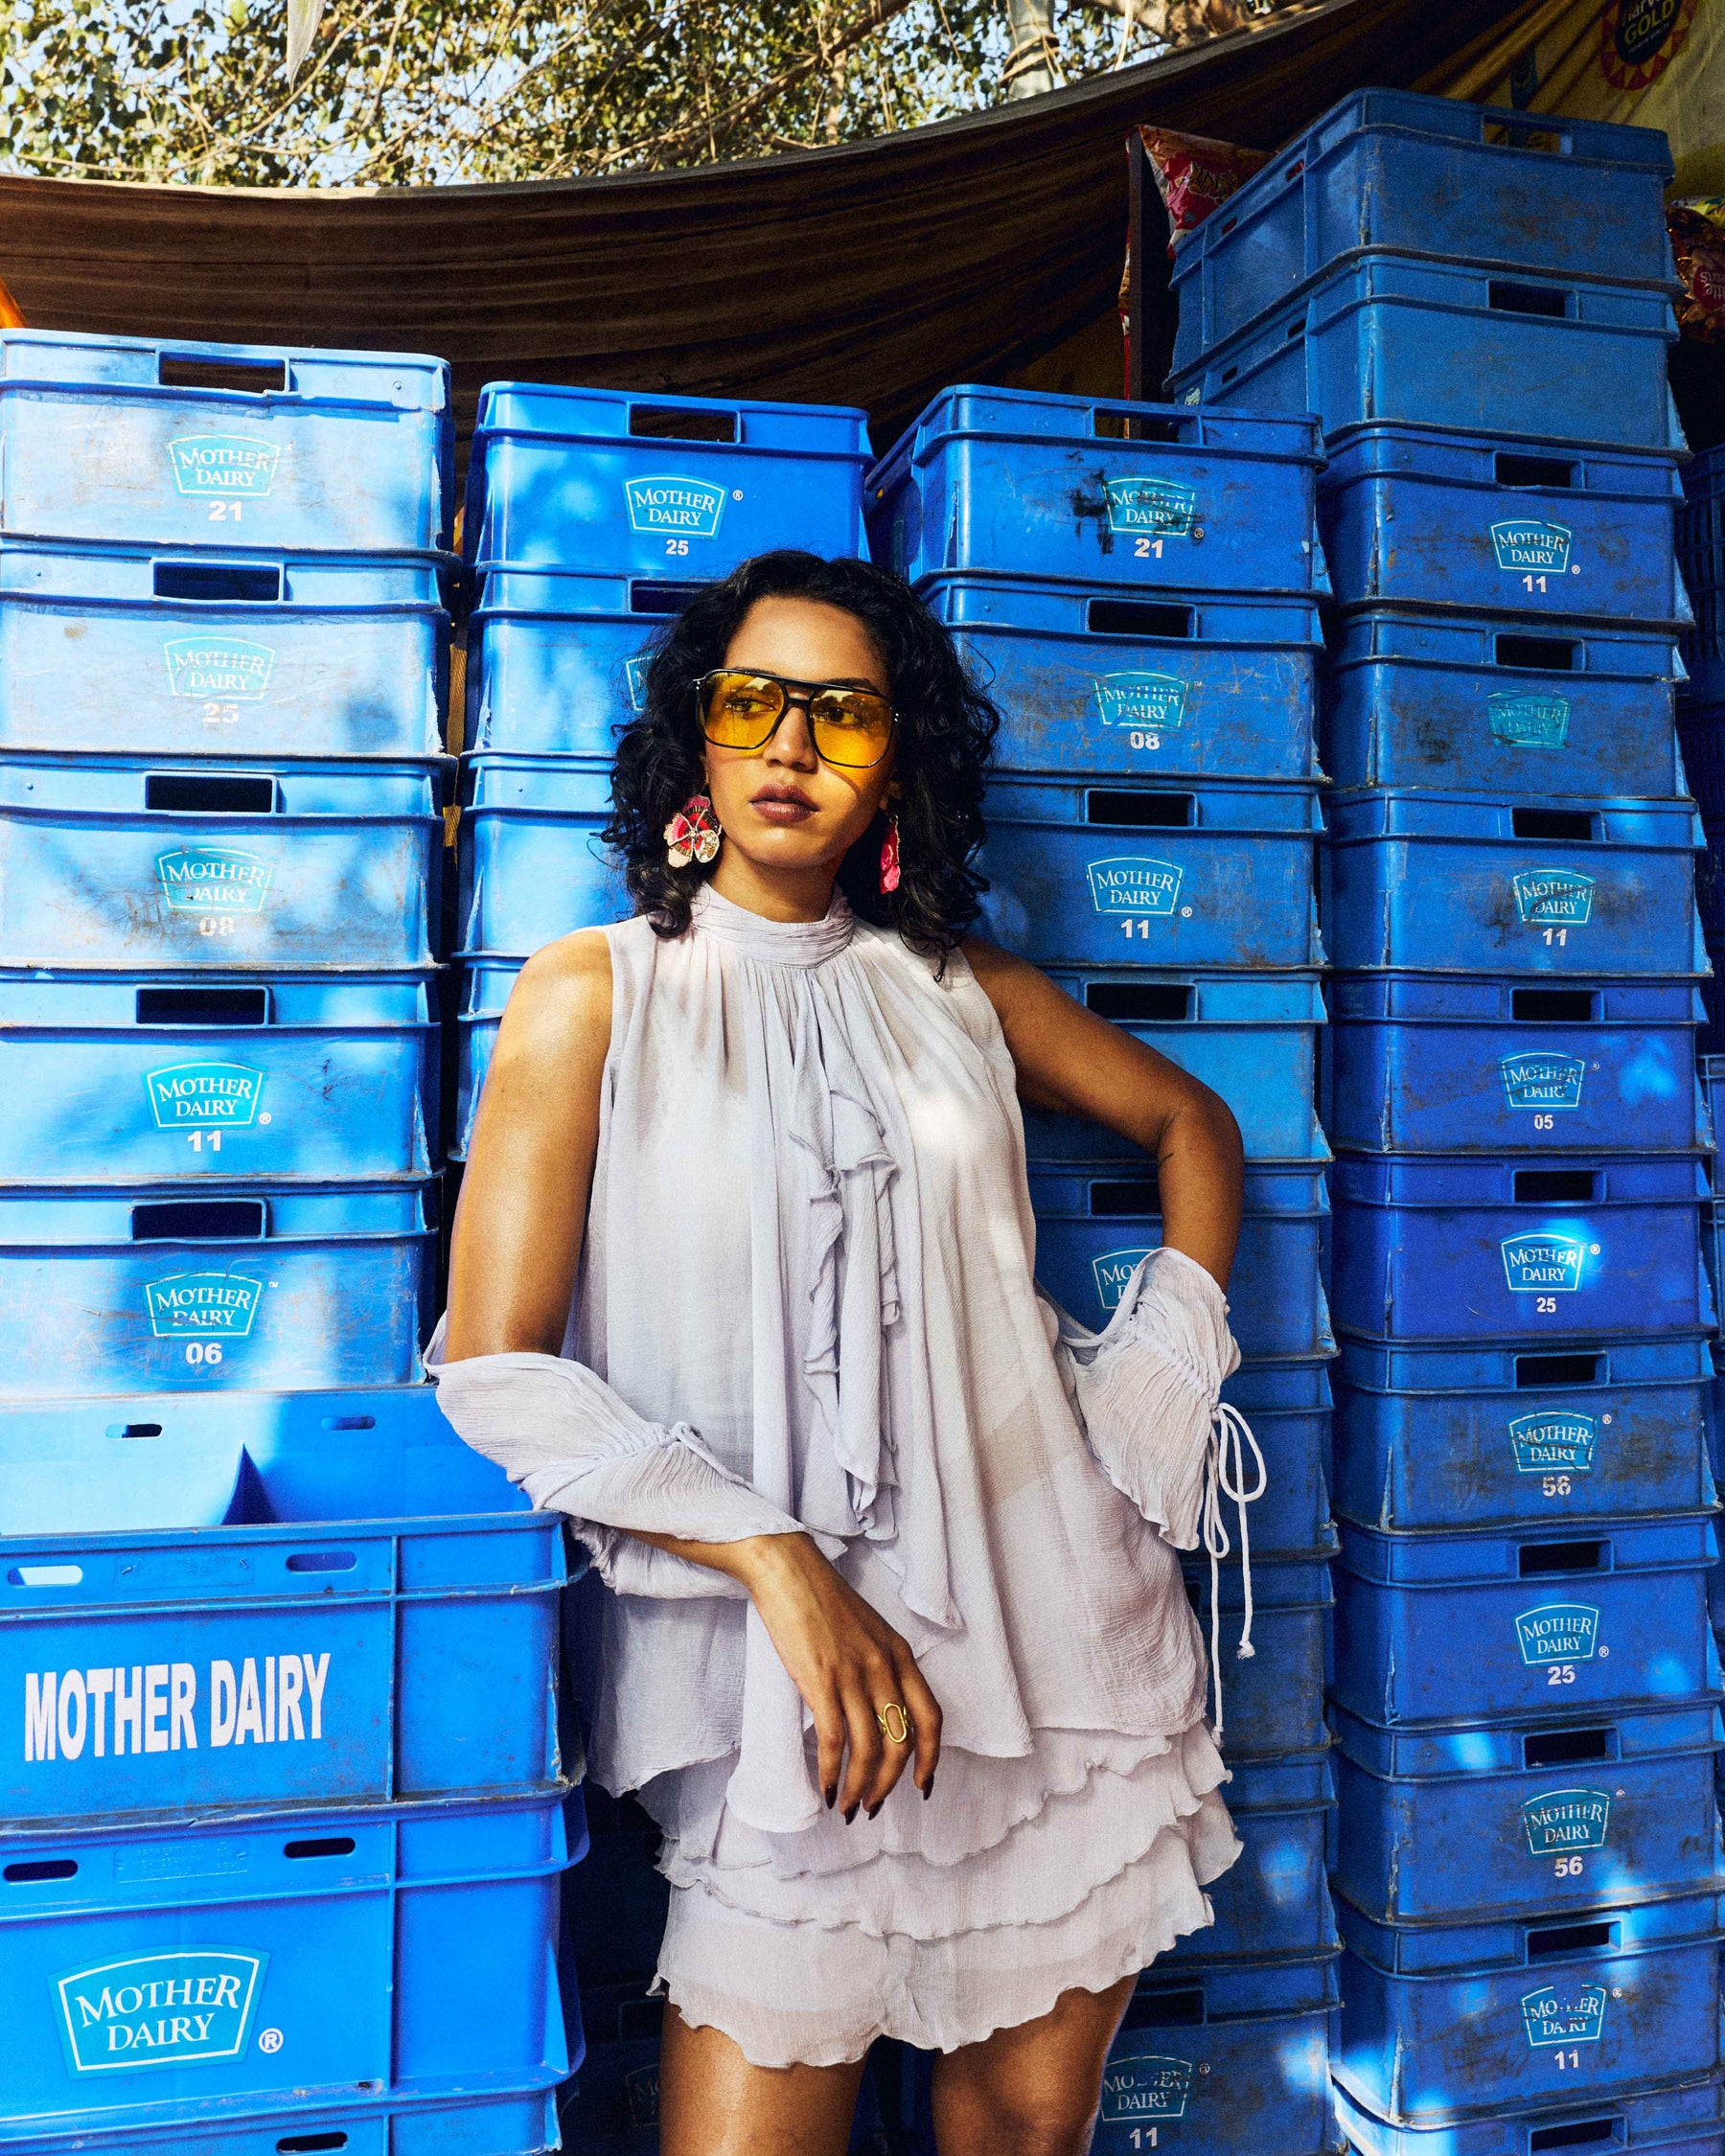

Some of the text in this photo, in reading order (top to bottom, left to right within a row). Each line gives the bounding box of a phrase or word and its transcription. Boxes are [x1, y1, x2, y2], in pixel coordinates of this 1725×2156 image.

[1624, 0, 1675, 45] GOLD
[178, 447, 271, 472] MOTHER
[196, 470, 256, 486] DAIRY
[208, 500, 242, 521] 21
[633, 488, 716, 514] MOTHER
[649, 508, 702, 526] DAIRY
[1126, 508, 1175, 525] DAIRY
[665, 539, 689, 556] 25
[1134, 538, 1163, 559] 21
[1498, 531, 1565, 553] MOTHER
[1511, 549, 1554, 564] DAIRY
[1522, 575, 1547, 593] 11
[173, 651, 264, 677] MOTHER
[190, 672, 250, 690] DAIRY
[202, 702, 240, 723] 25
[1130, 731, 1161, 750] 08
[167, 861, 265, 887] MOTHER
[1096, 870, 1174, 892] MOTHER
[1111, 889, 1162, 906] DAIRY
[1522, 881, 1588, 902] MOTHER
[1535, 901, 1577, 915] DAIRY
[199, 916, 235, 936] 08
[1121, 919, 1149, 939] 11
[1542, 928, 1567, 947] 11
[156, 1077, 253, 1102] MOTHER
[175, 1099, 238, 1117] DAIRY
[1534, 1114, 1553, 1130] 05
[187, 1131, 221, 1153] 11
[1508, 1249, 1577, 1269] MOTHER
[1522, 1267, 1567, 1281] DAIRY
[154, 1287, 251, 1311] MOTHER
[1536, 1296, 1556, 1313] 25
[172, 1310, 236, 1326] DAIRY
[185, 1342, 222, 1365] 06
[1516, 1426, 1588, 1448] MOTHER
[1530, 1447, 1576, 1462] DAIRY
[1542, 1476, 1571, 1497] 56
[1523, 1617, 1592, 1641] MOTHER
[1537, 1637, 1581, 1654] DAIRY
[1548, 1664, 1576, 1686] 25
[25, 1653, 331, 1762] MOTHER DAIRY
[1530, 1803, 1602, 1830] MOTHER
[1545, 1824, 1591, 1844] DAIRY
[1554, 1855, 1583, 1878] 56
[75, 1974, 241, 2029] MOTHER
[1530, 1996, 1599, 2022] MOER
[107, 2012, 216, 2051] DAIRY
[1554, 2050, 1579, 2070] 11
[1117, 2092, 1171, 2110] DAIRY
[1129, 2126, 1158, 2149] 11
